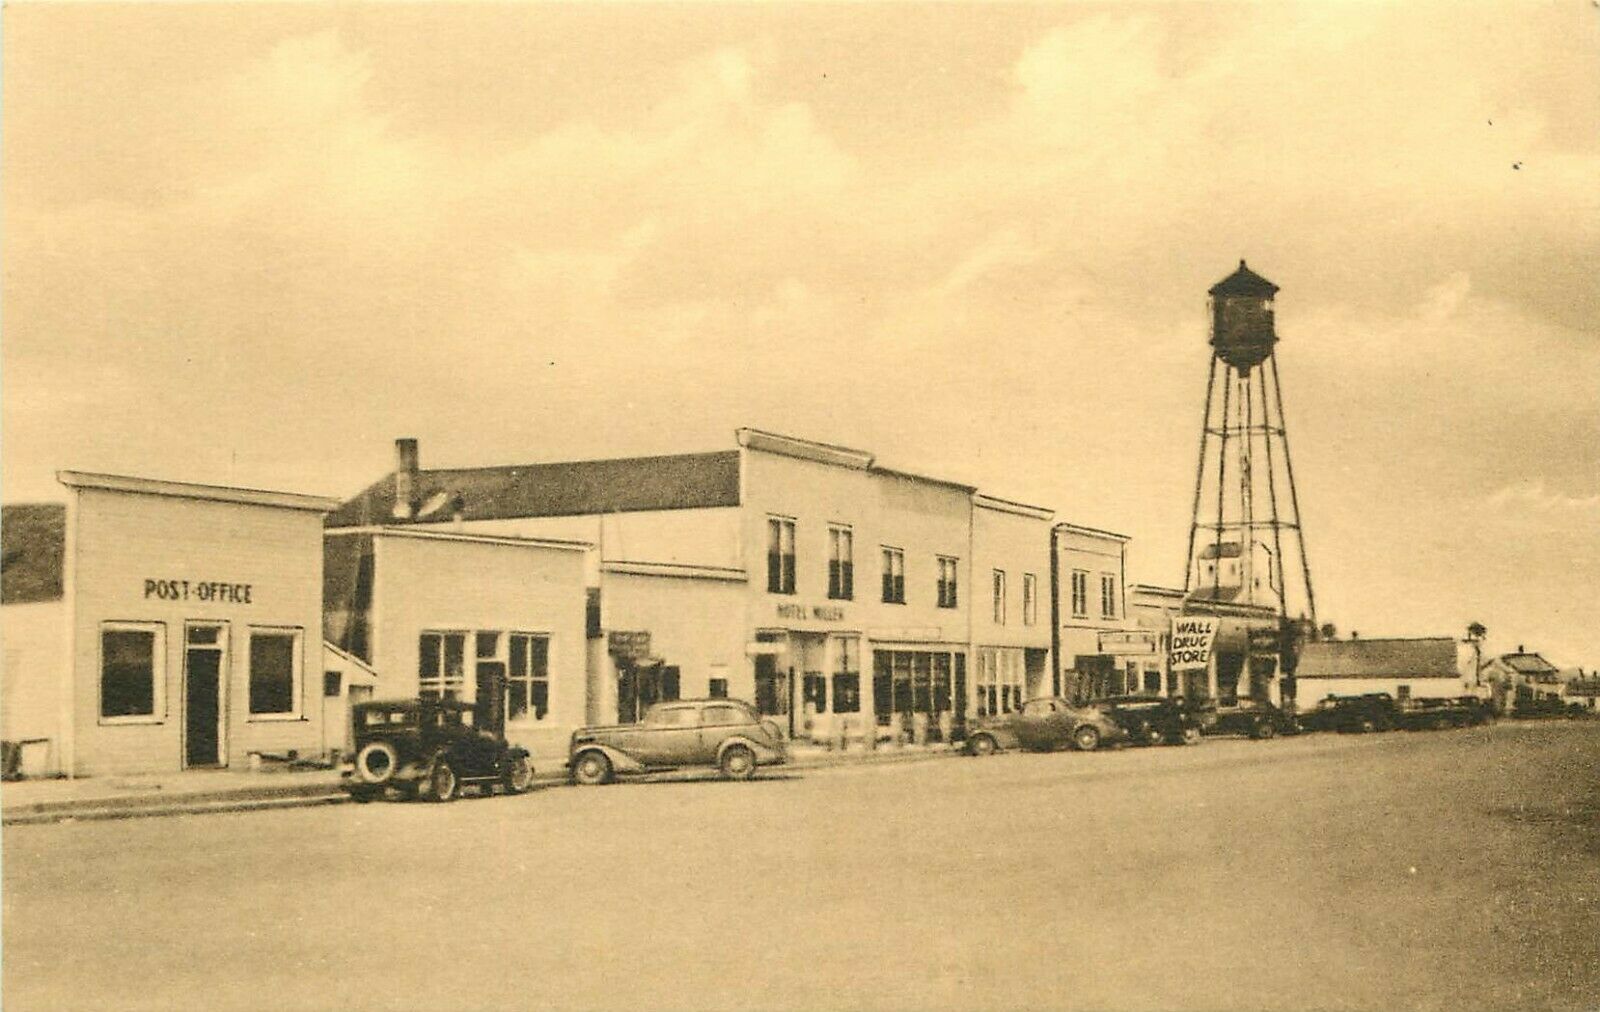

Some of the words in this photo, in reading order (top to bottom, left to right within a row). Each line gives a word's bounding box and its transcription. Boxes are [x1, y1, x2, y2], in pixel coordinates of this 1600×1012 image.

[1176, 622, 1211, 634] WALL
[1173, 636, 1207, 649] DRUG
[1171, 650, 1208, 666] STORE
